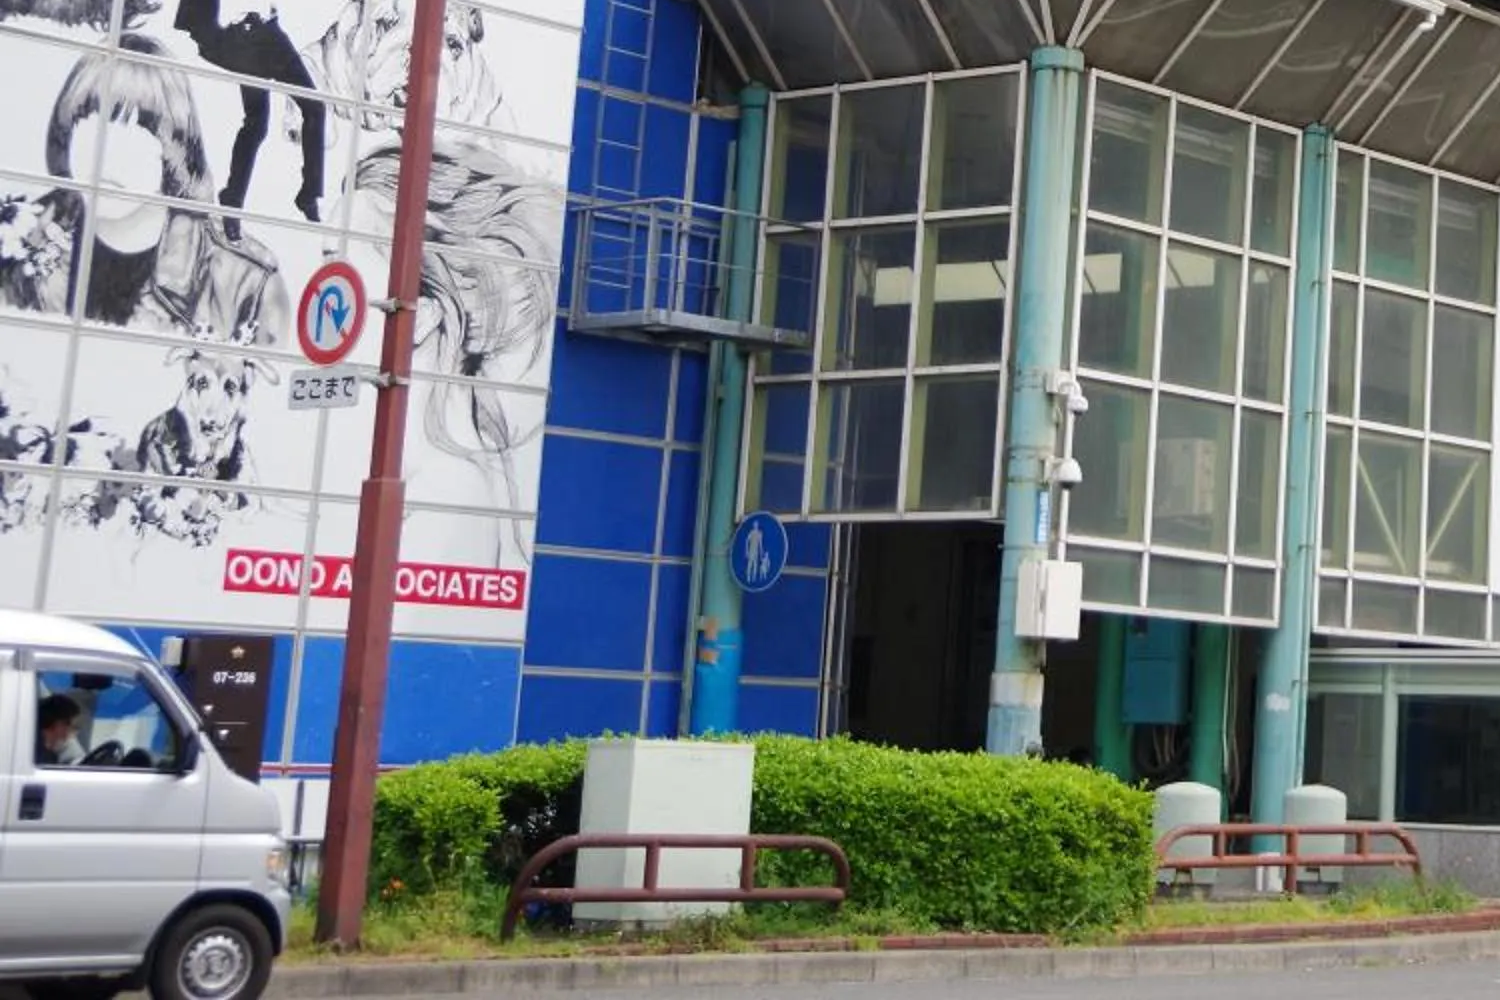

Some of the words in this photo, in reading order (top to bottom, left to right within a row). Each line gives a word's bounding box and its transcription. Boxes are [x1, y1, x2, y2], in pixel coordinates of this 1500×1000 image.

[293, 376, 355, 401] ここまで
[332, 563, 517, 603] AOCIATES
